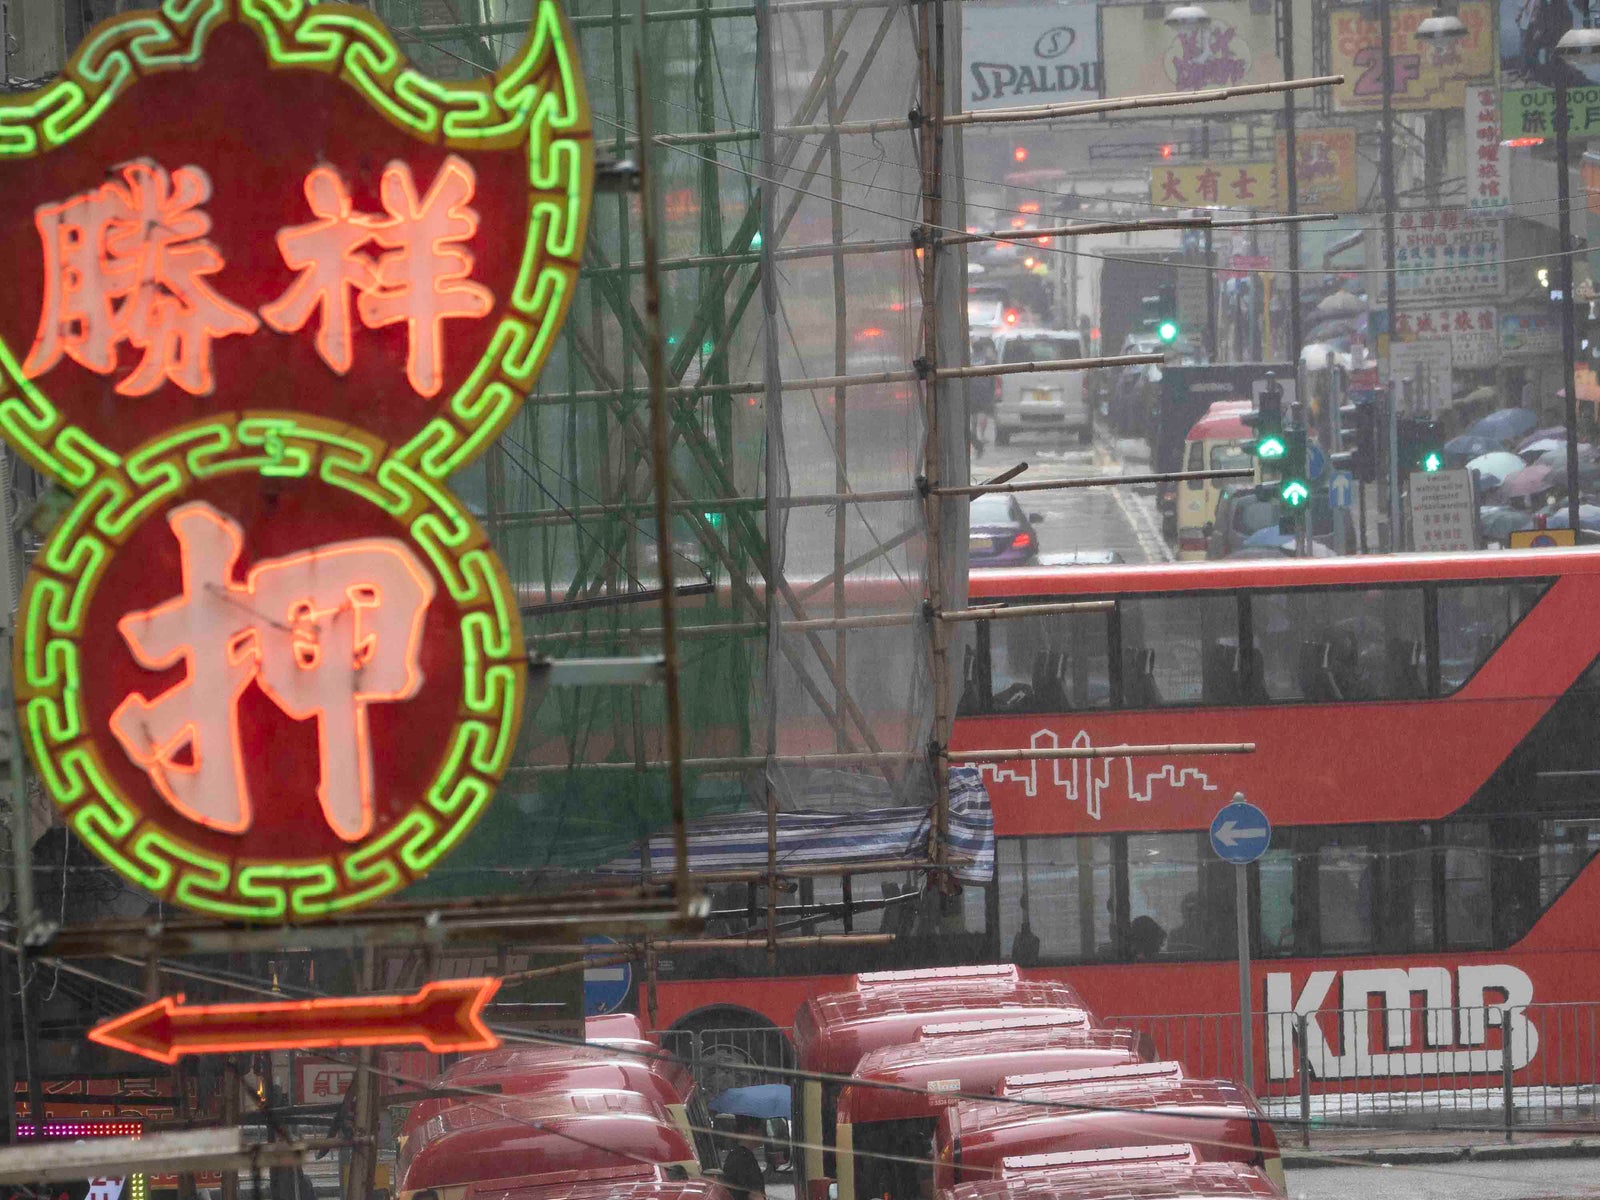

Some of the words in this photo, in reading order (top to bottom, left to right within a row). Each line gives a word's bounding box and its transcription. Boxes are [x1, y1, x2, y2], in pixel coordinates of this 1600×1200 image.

[1454, 230, 1498, 243] HOTEL
[111, 501, 435, 840] 押
[1265, 964, 1539, 1081] KMB
